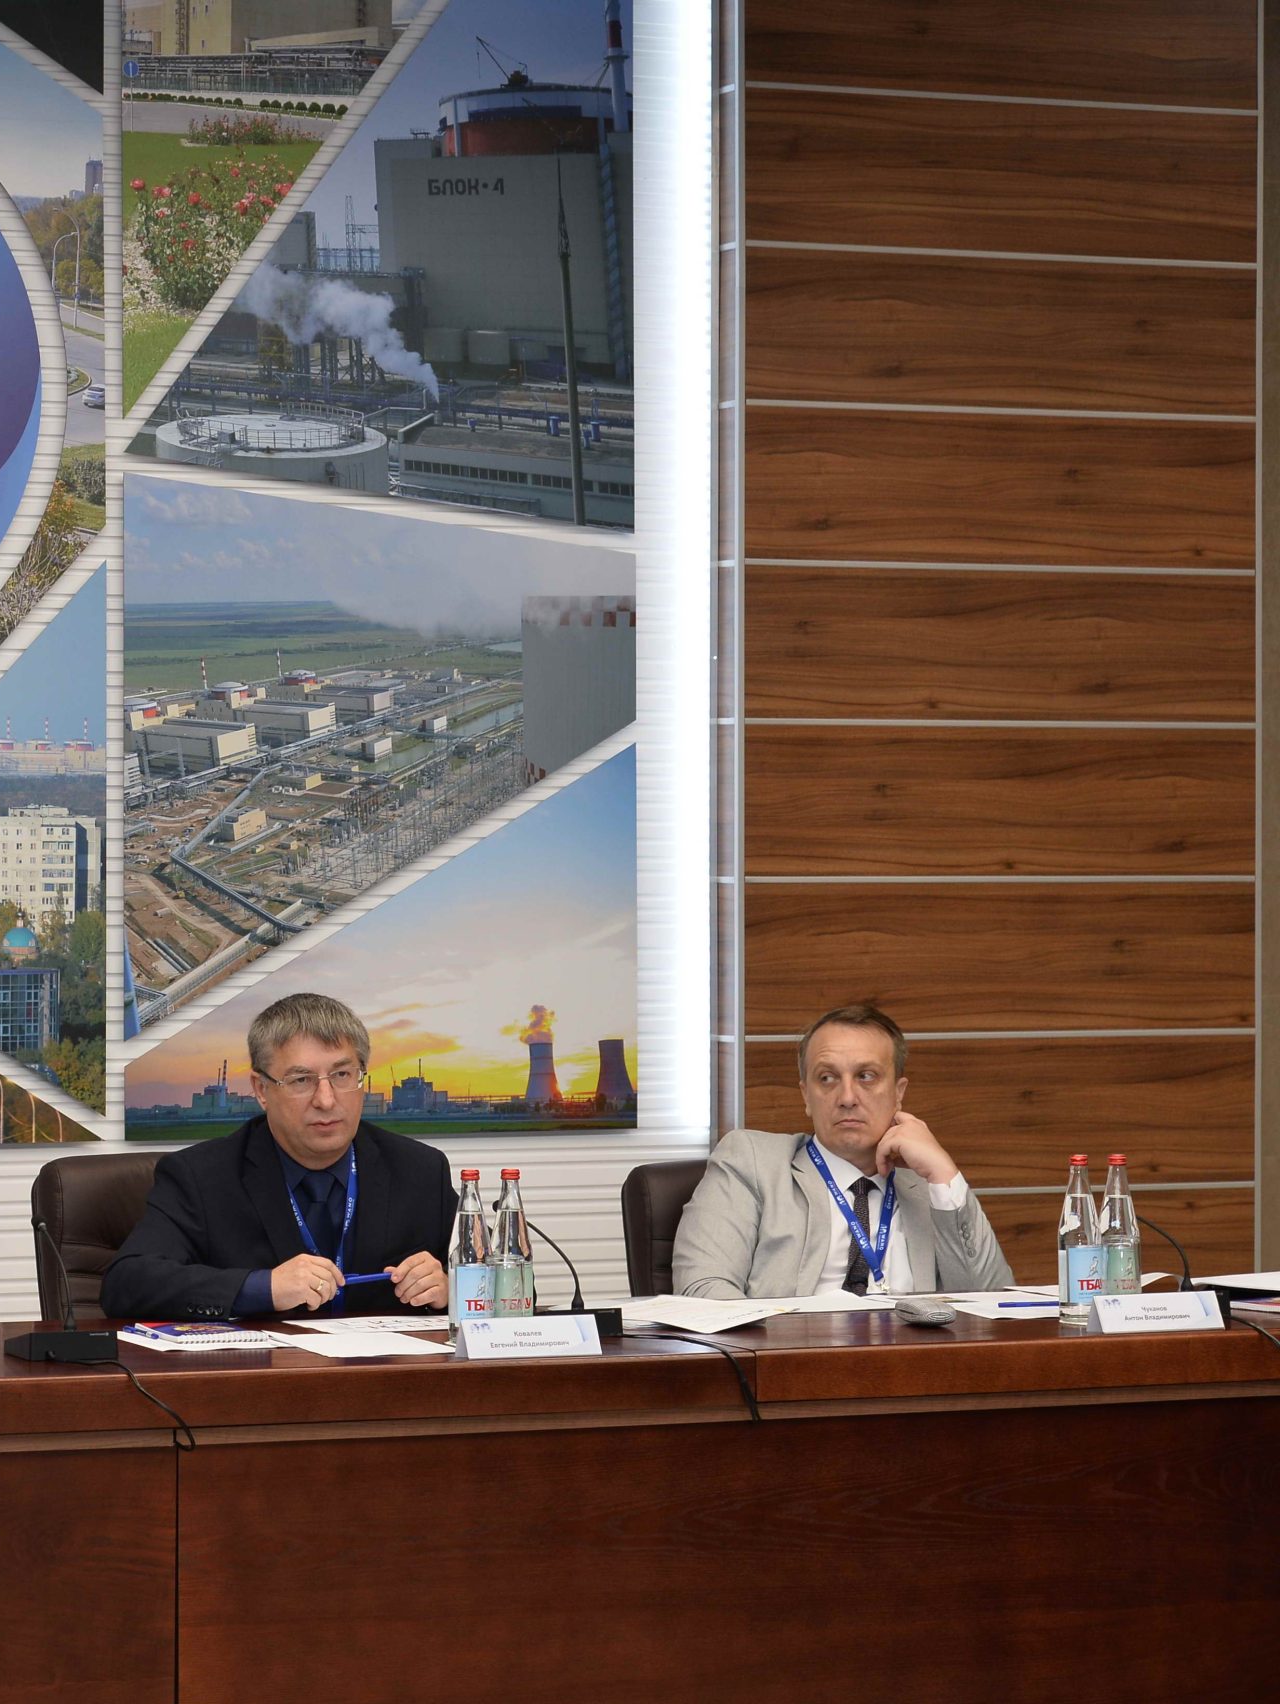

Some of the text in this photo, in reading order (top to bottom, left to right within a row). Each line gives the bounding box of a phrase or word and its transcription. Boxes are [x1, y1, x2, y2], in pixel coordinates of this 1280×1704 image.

[827, 1180, 838, 1196] WANO
[292, 1205, 303, 1227] WANO
[850, 1221, 861, 1239] WANO
[878, 1232, 886, 1251] WANO
[490, 1340, 570, 1349] Евгений Владимирович
